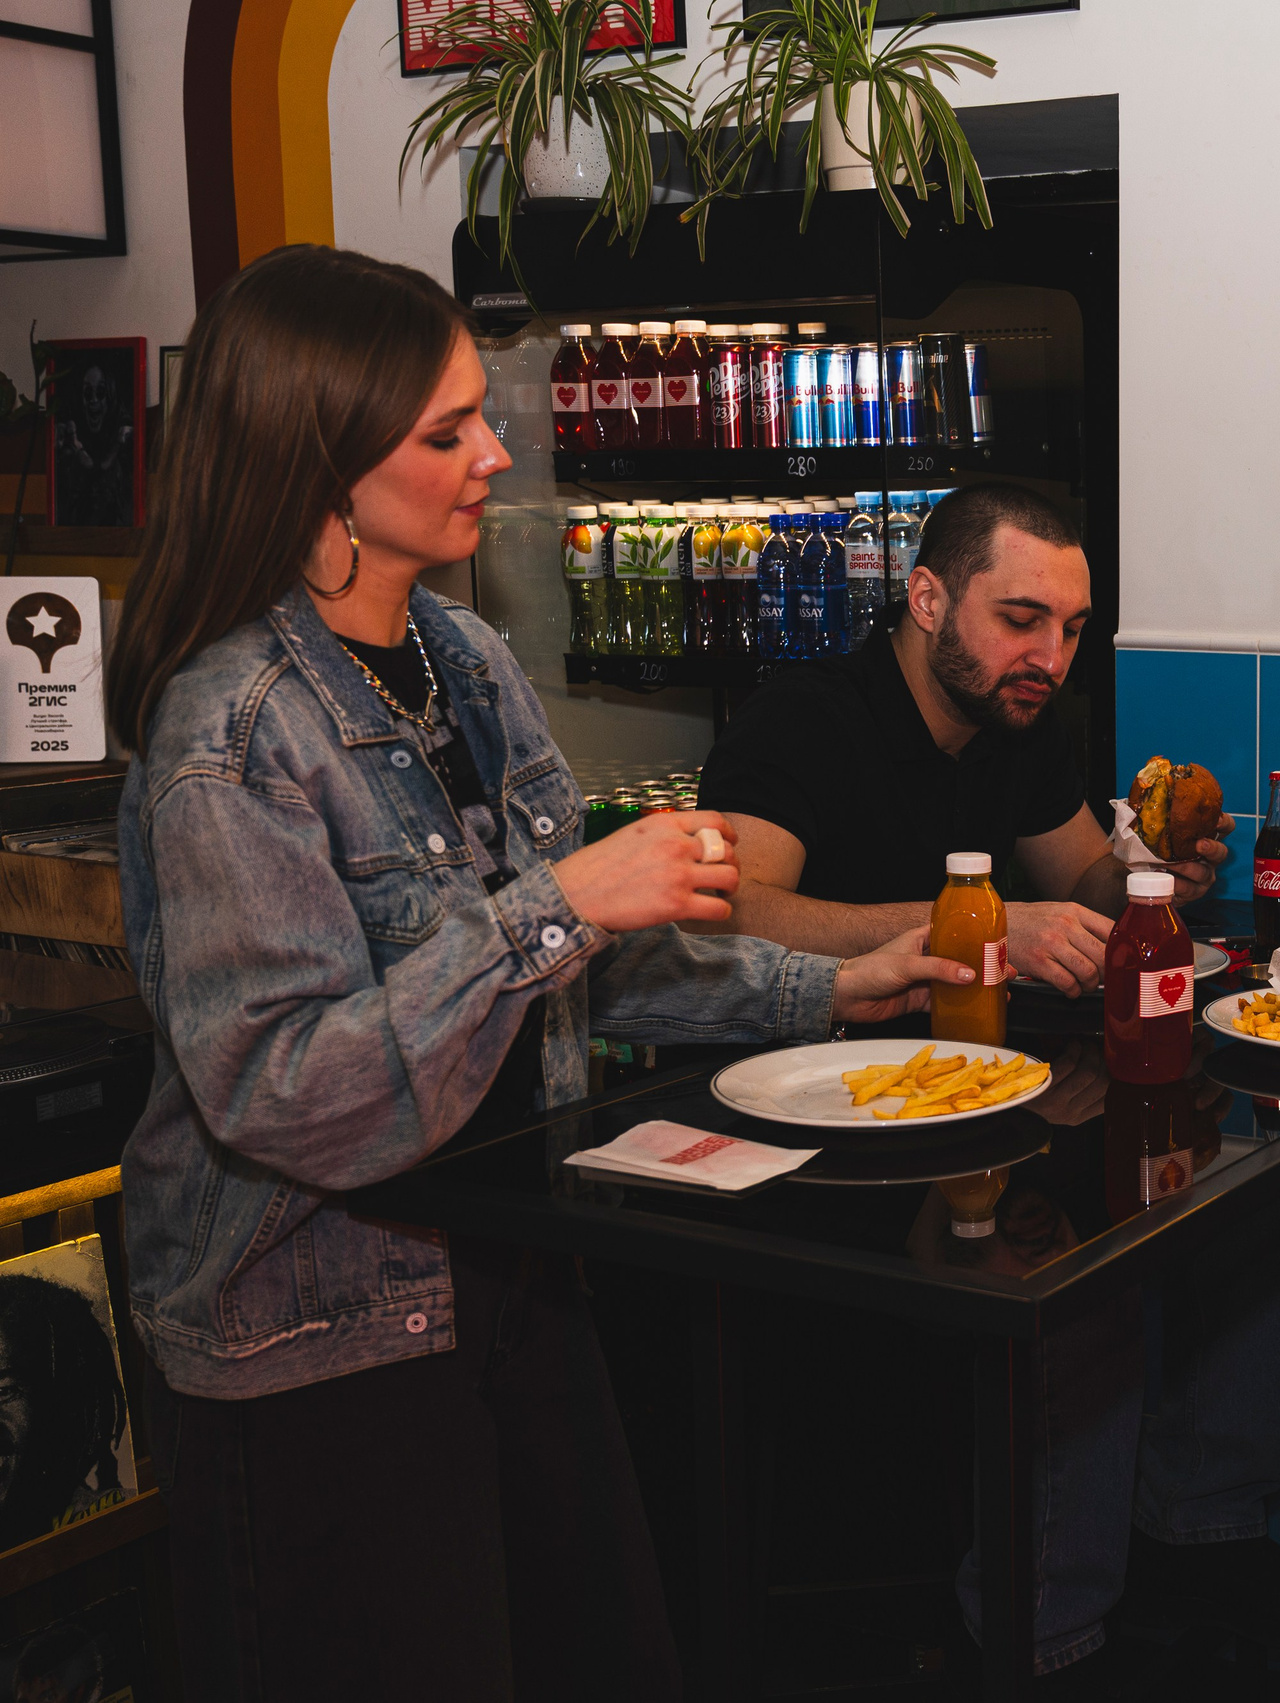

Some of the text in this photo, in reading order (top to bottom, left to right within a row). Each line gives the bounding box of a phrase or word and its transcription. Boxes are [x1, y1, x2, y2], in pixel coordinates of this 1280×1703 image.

[473, 297, 528, 307] Carboma
[719, 361, 742, 382] Dr
[752, 365, 784, 398] Pepp
[854, 383, 874, 395] Bul
[715, 406, 727, 419] 23
[756, 405, 767, 418] 23
[787, 456, 817, 477] 280
[907, 456, 934, 472] 250
[849, 562, 881, 571] SPRING
[758, 607, 785, 617] SSAY
[799, 607, 824, 618] SSAY
[640, 661, 668, 681] 200
[18, 682, 76, 695] Премия
[29, 696, 67, 707] 2ГИС
[31, 740, 69, 752] 2025
